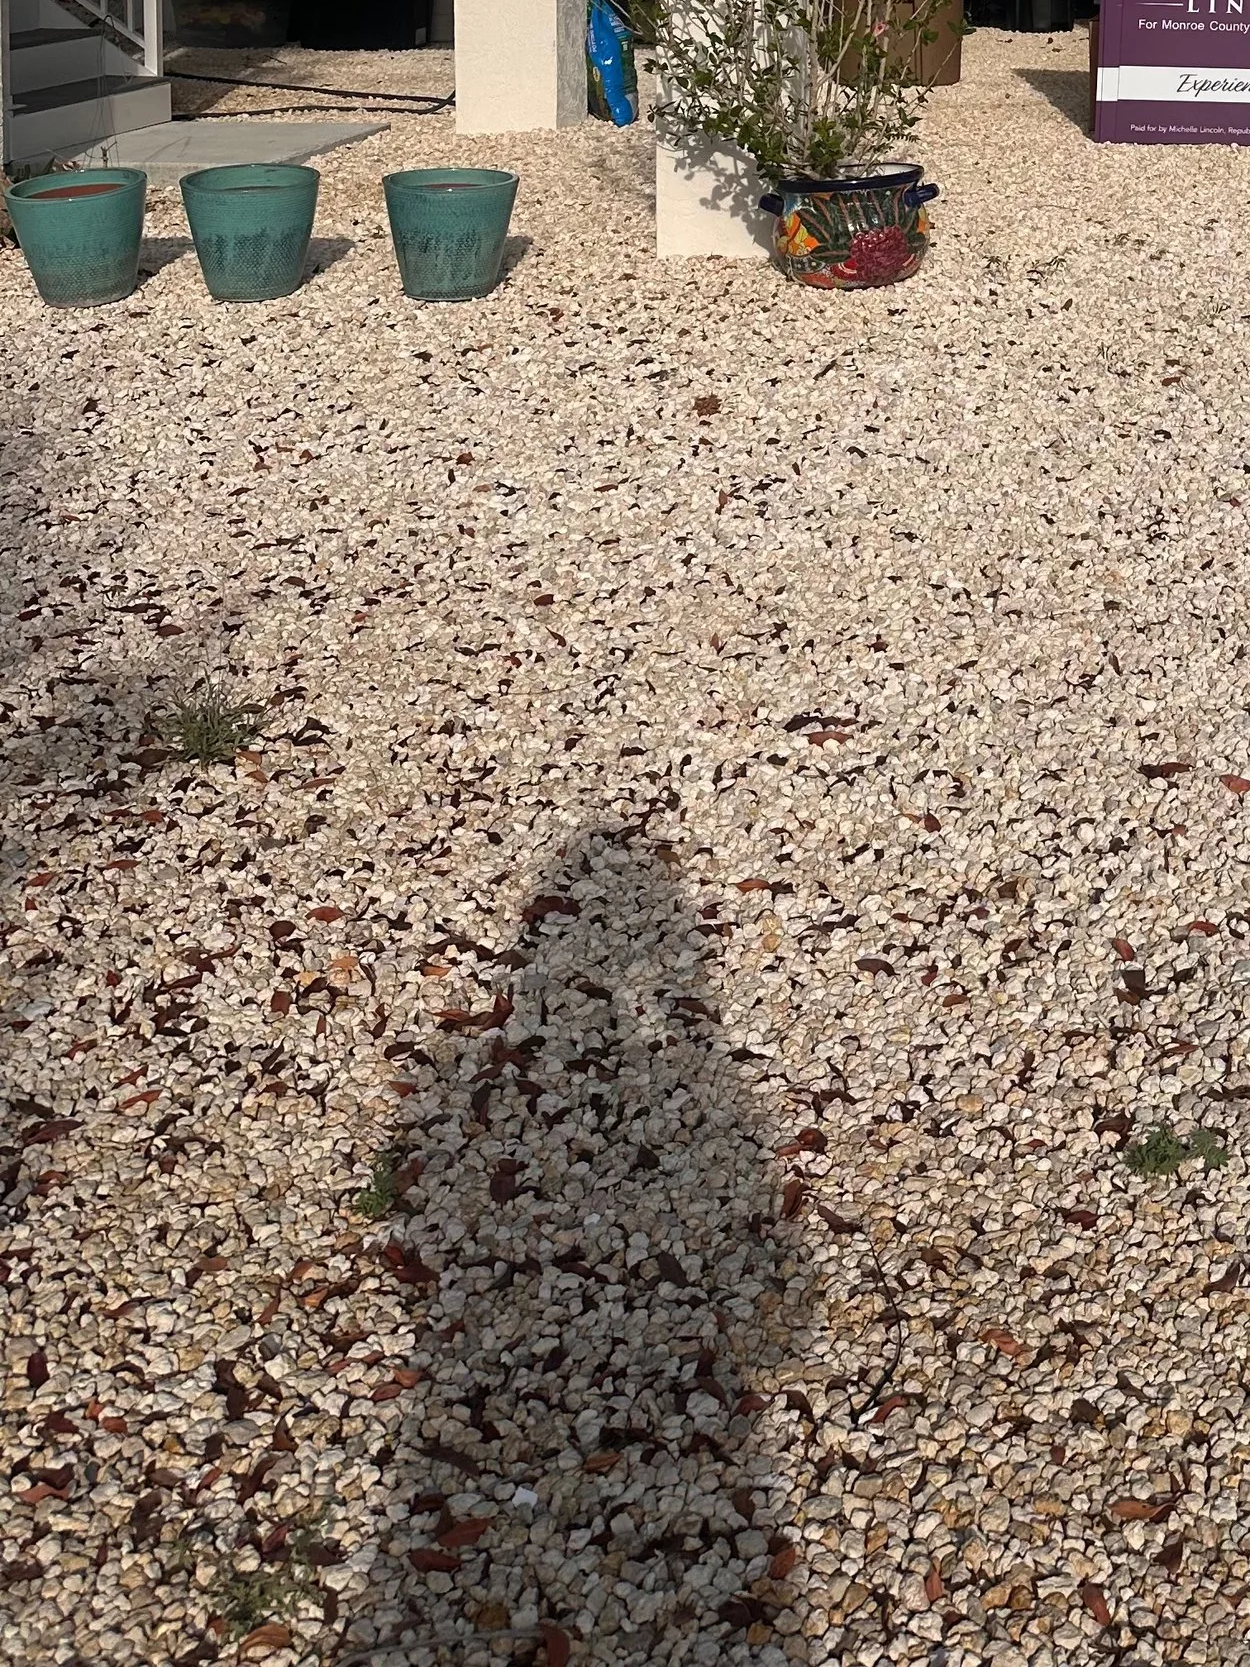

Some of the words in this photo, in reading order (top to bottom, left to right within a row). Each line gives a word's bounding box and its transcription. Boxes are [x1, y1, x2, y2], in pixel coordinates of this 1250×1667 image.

[1138, 19, 1157, 30] For
[1162, 20, 1205, 31] Monroe
[1209, 21, 1250, 34] County
[1130, 123, 1146, 132] Paid
[1147, 123, 1157, 132] for
[1158, 124, 1167, 133] by
[1169, 125, 1198, 133] Michelle
[1200, 125, 1226, 134] Lincoln,
